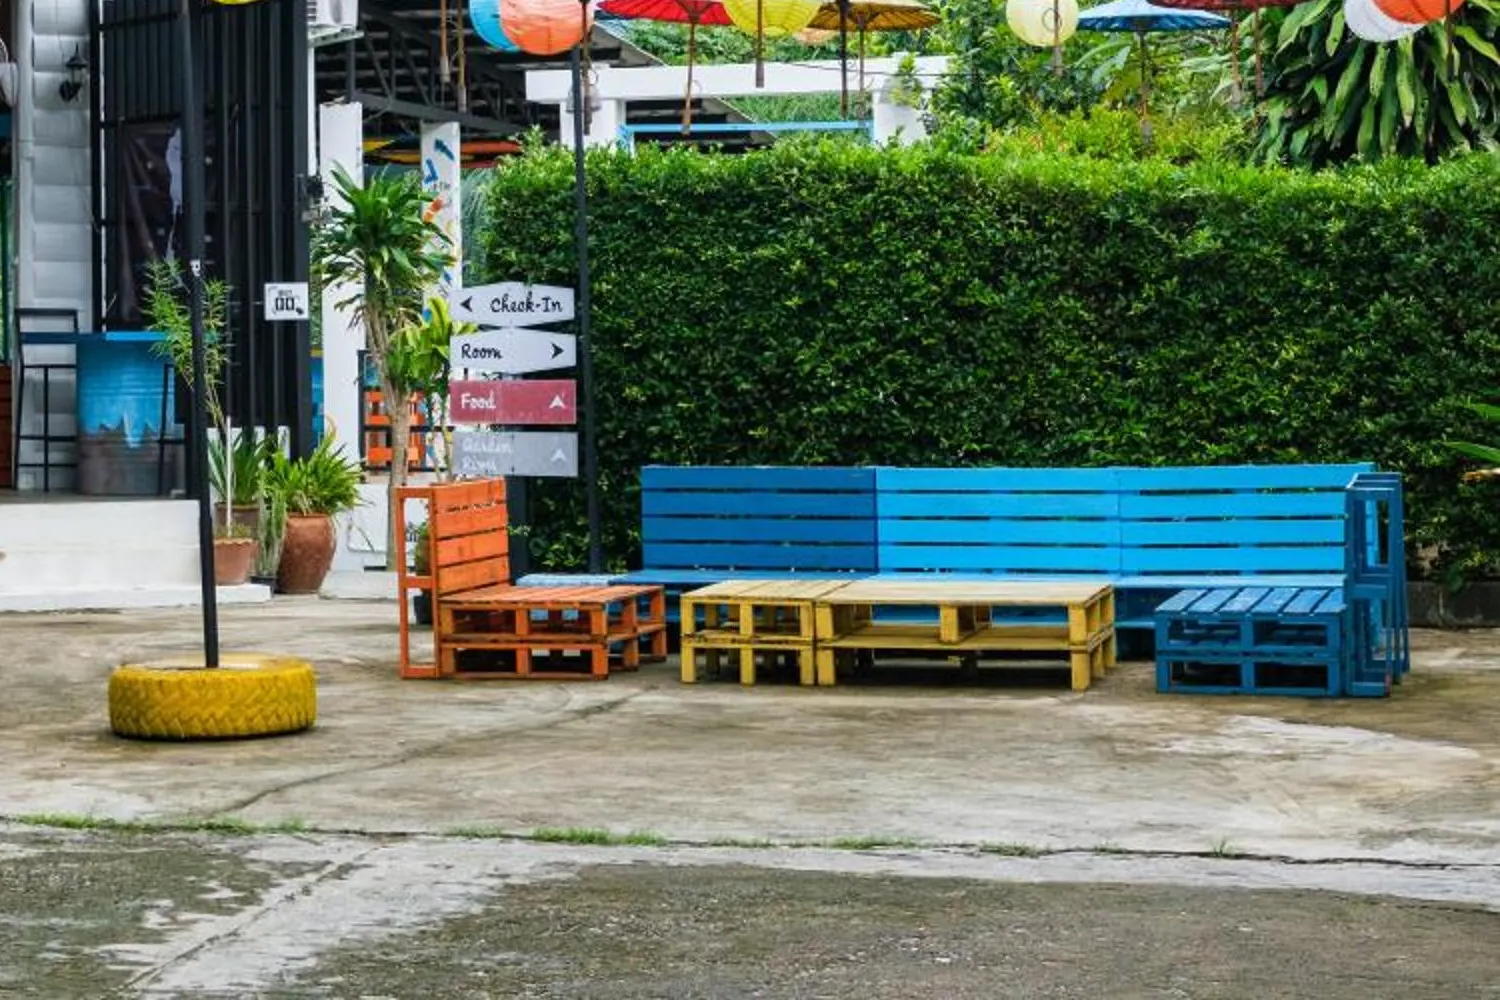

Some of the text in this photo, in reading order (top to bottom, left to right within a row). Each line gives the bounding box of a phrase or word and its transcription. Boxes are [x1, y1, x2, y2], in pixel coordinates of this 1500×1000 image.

[489, 292, 564, 314] Check-In
[461, 343, 503, 360] Room
[460, 391, 497, 410] Food
